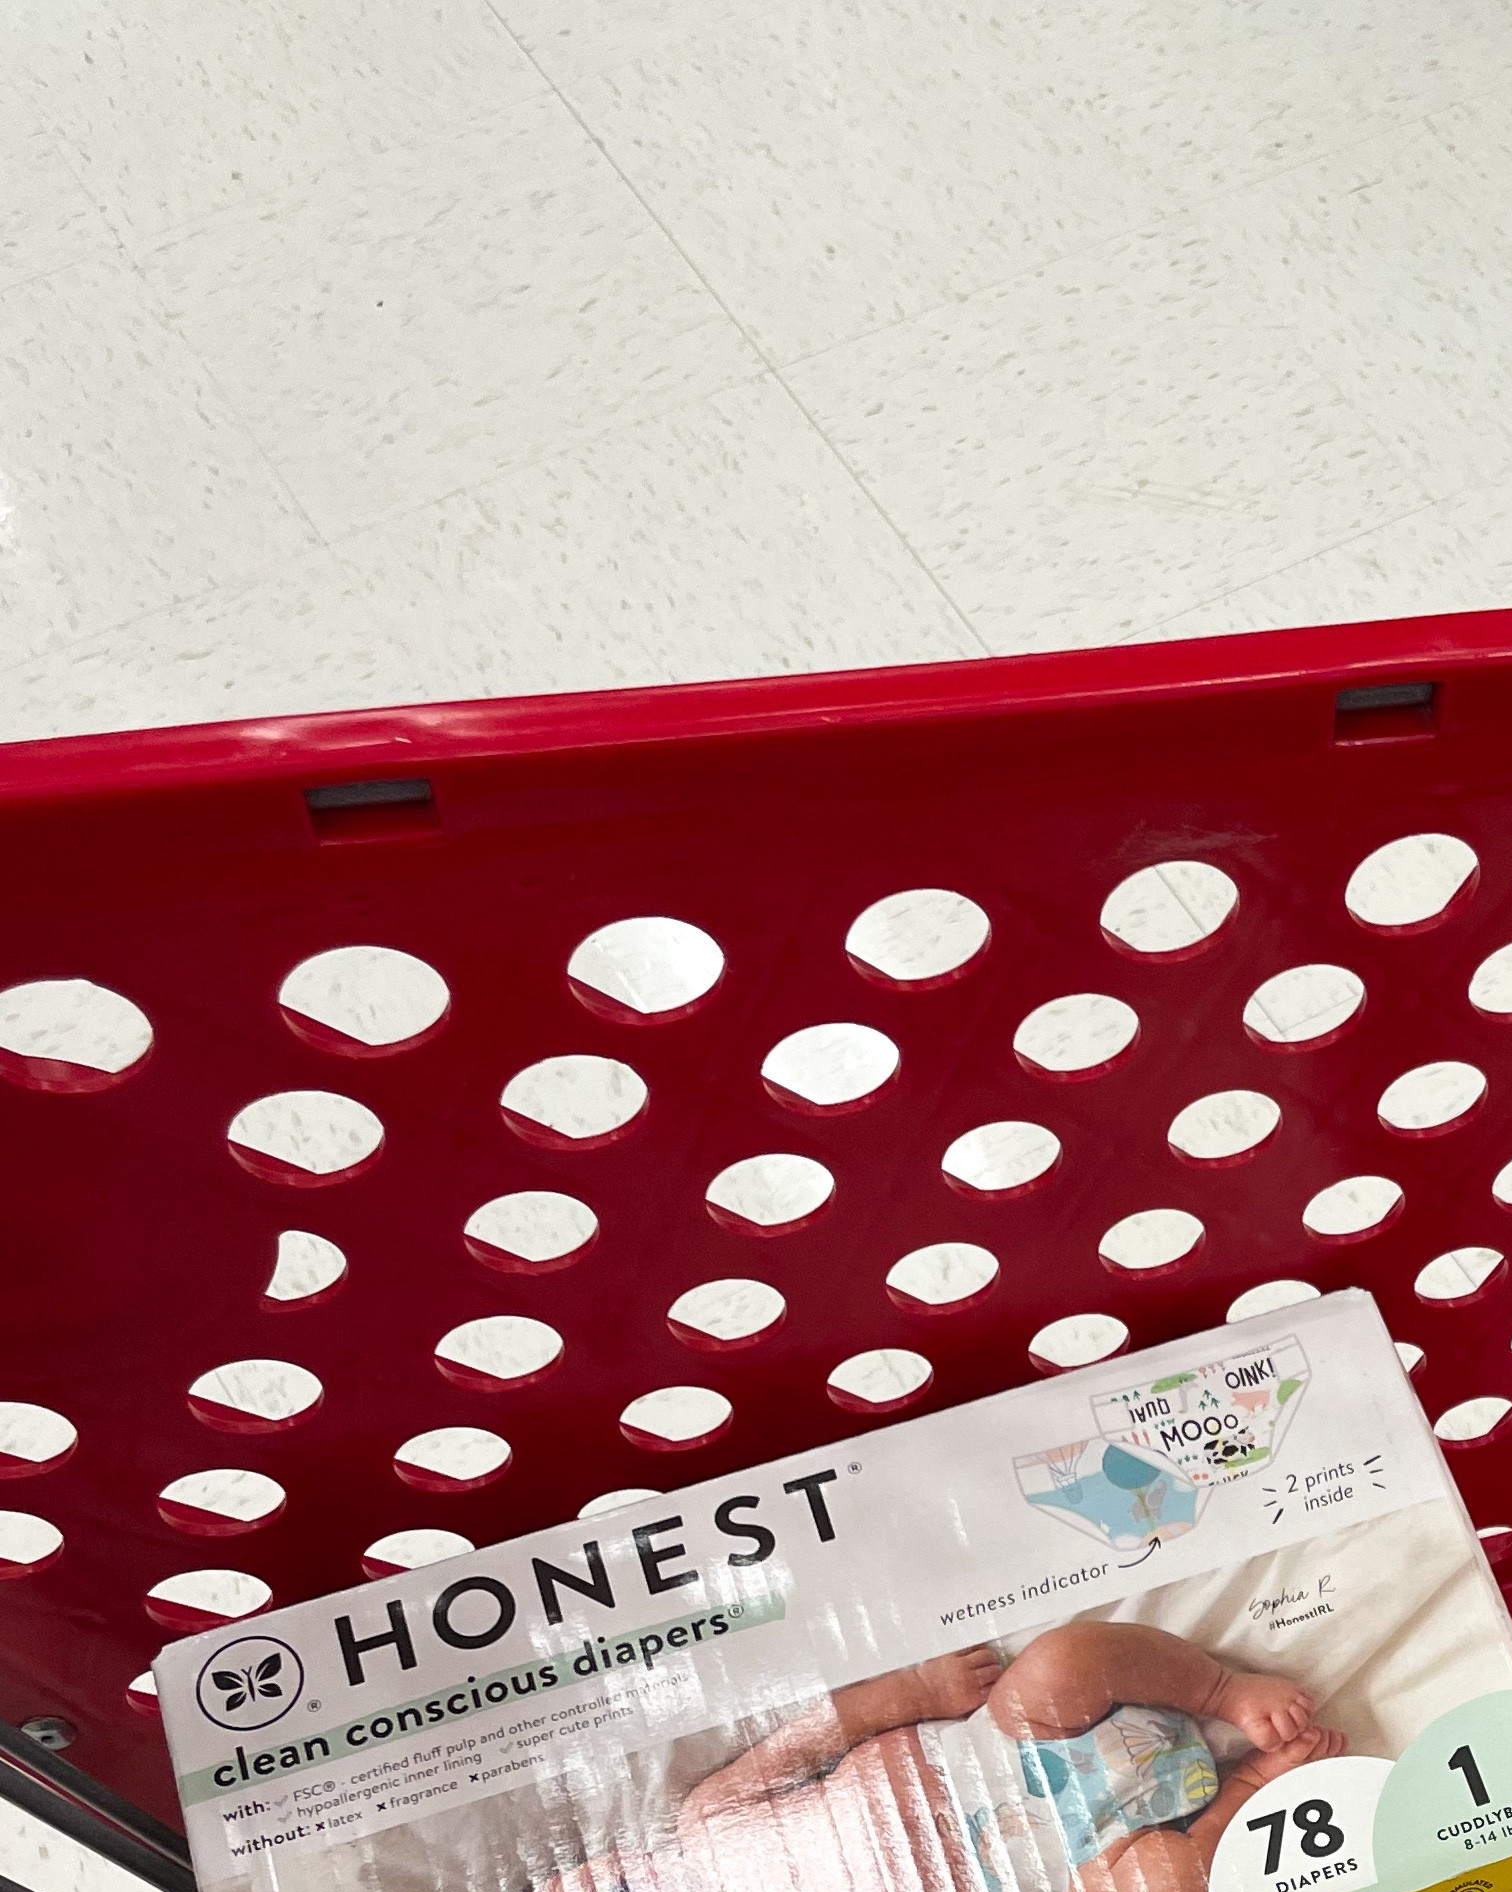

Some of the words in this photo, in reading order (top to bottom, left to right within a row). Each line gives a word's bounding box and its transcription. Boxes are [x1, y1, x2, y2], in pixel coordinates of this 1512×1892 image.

[1225, 1357, 1277, 1390] OINK!
[1285, 1473, 1299, 1494] 2
[1303, 1460, 1356, 1496] prints
[1303, 1484, 1354, 1513] inside
[939, 1592, 1016, 1627] wetness
[1021, 1560, 1109, 1601] indicator
[1317, 1574, 1337, 1595] R
[1268, 1602, 1335, 1632] #HonestIRL
[213, 1745, 330, 1787] clean
[345, 1661, 559, 1748] conscious
[222, 1800, 272, 1823] with:
[350, 1757, 409, 1785] certified
[413, 1744, 442, 1766] fluff
[446, 1737, 476, 1758] pulp
[480, 1728, 505, 1745] and
[509, 1716, 547, 1736] other
[550, 1691, 622, 1723] controlled
[296, 1778, 401, 1818] hypoallergenic
[403, 1765, 439, 1784] inner
[443, 1752, 483, 1772] lining
[516, 1730, 554, 1753] super
[559, 1719, 590, 1736] cute
[594, 1704, 634, 1729] prints
[1447, 1744, 1491, 1807] 1
[231, 1824, 311, 1857] without:
[327, 1810, 363, 1829] latex
[389, 1780, 458, 1809] fragrance
[481, 1753, 545, 1784] parabens
[1246, 1798, 1345, 1876] 78
[1463, 1830, 1498, 1851] 8-14
